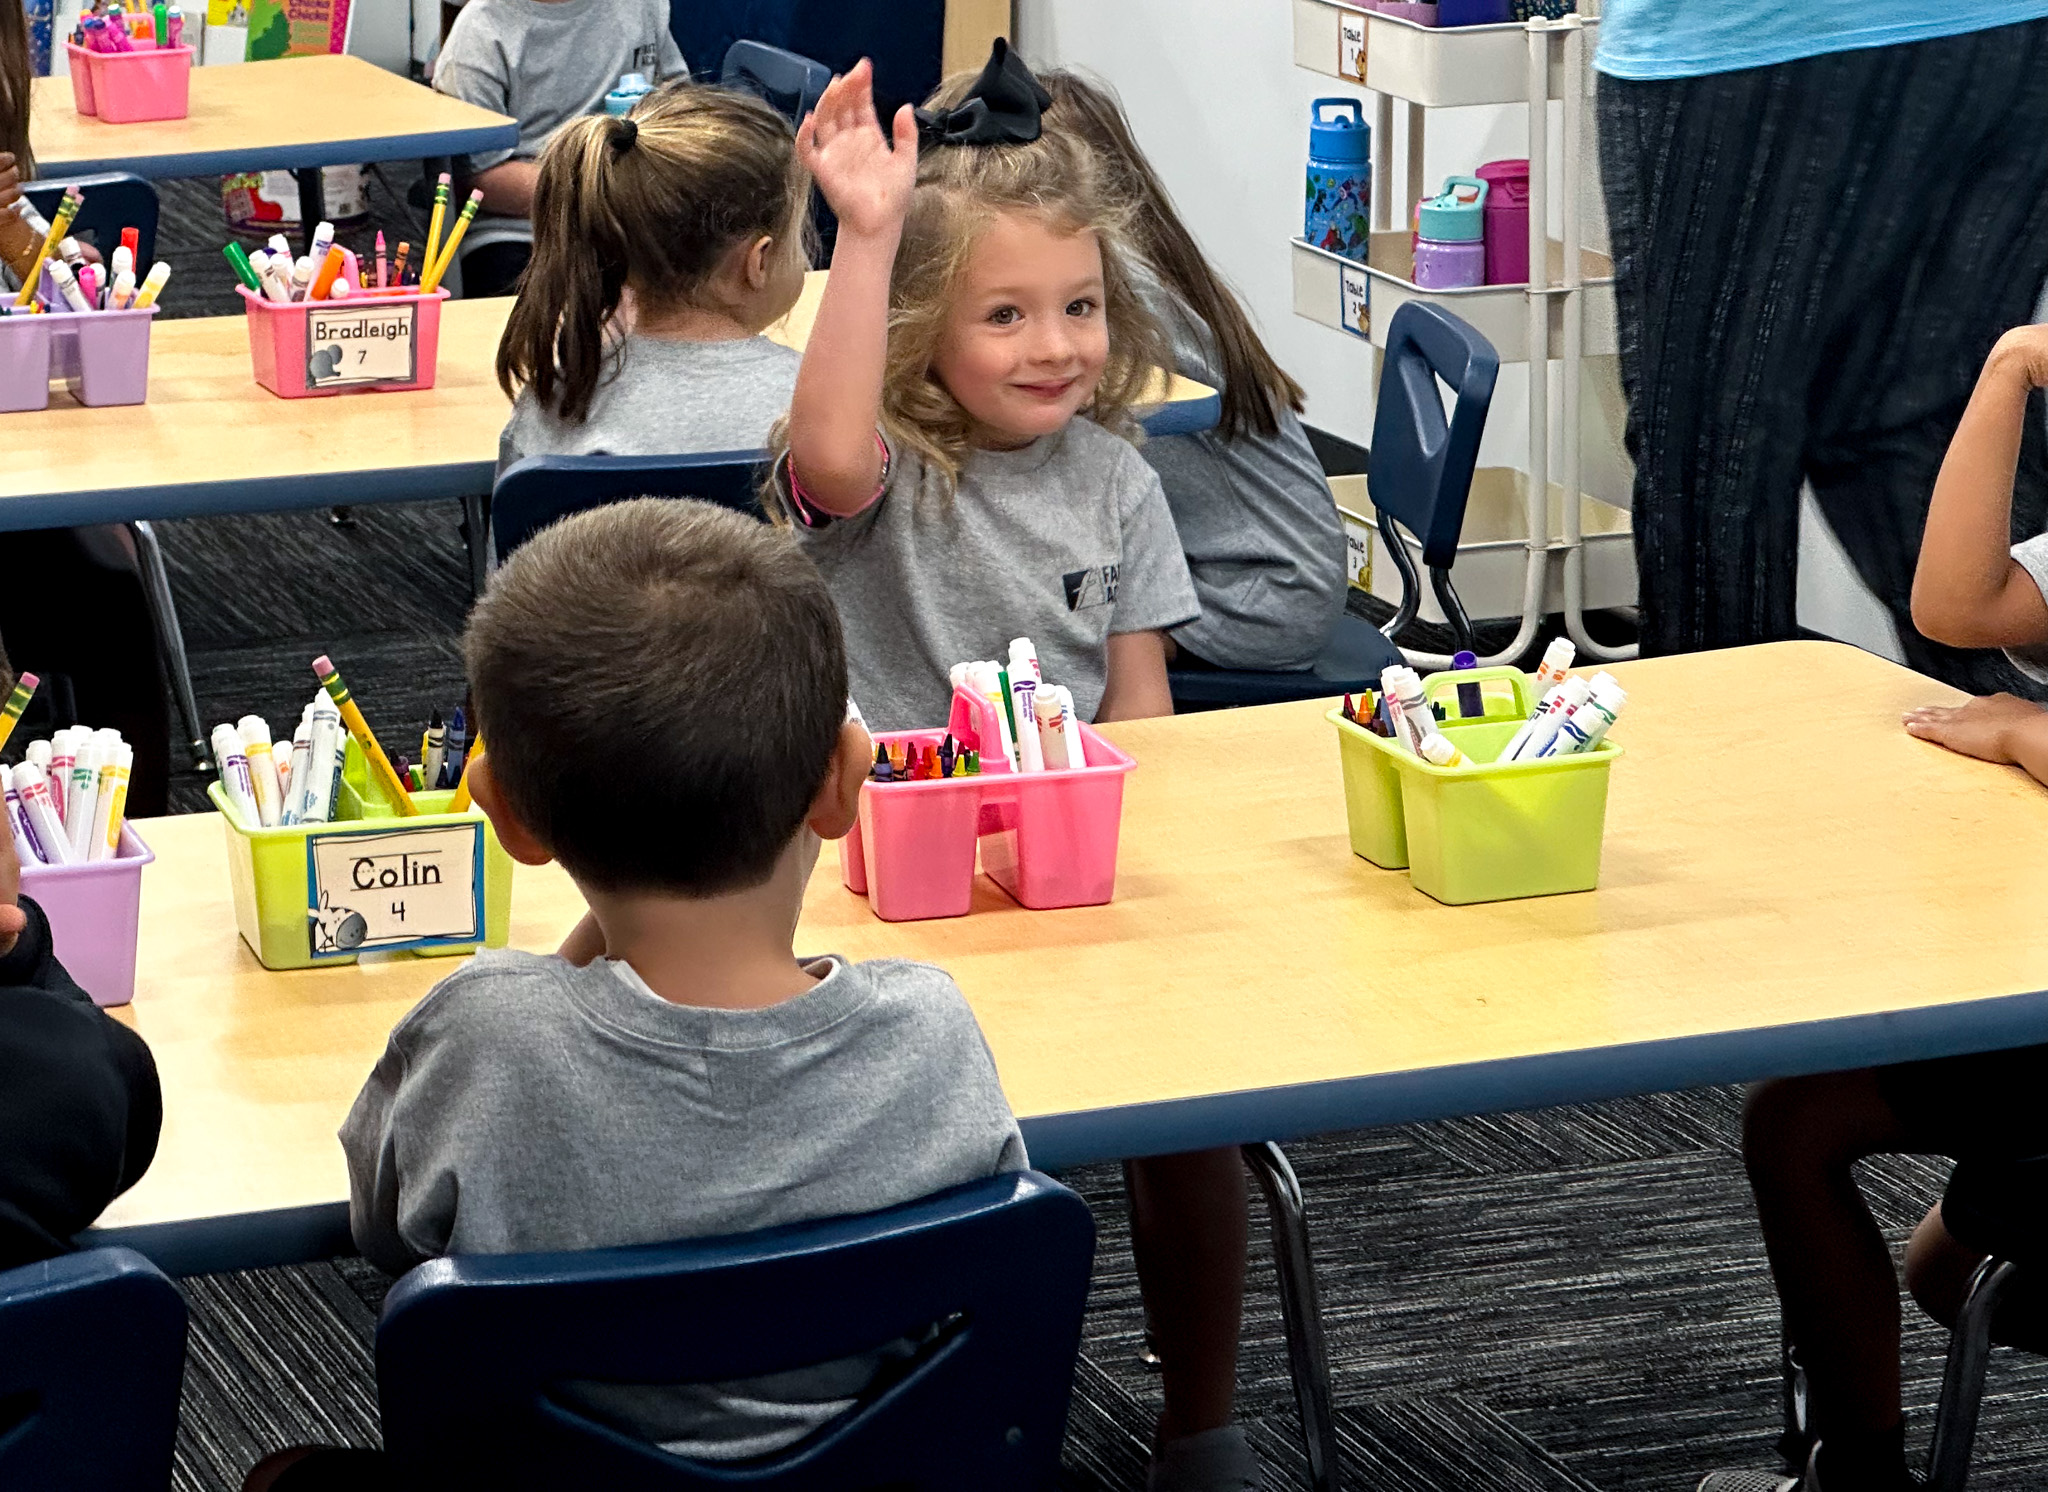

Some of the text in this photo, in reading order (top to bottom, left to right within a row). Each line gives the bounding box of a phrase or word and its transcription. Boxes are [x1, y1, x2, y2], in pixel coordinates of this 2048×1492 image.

[1343, 27, 1361, 42] Table
[1350, 47, 1354, 60] 1
[1345, 280, 1363, 297] Table
[1352, 302, 1357, 314] 2
[316, 317, 408, 341] Bradleigh
[358, 350, 367, 364] 7
[353, 854, 440, 889] Colin
[391, 901, 406, 922] 4
